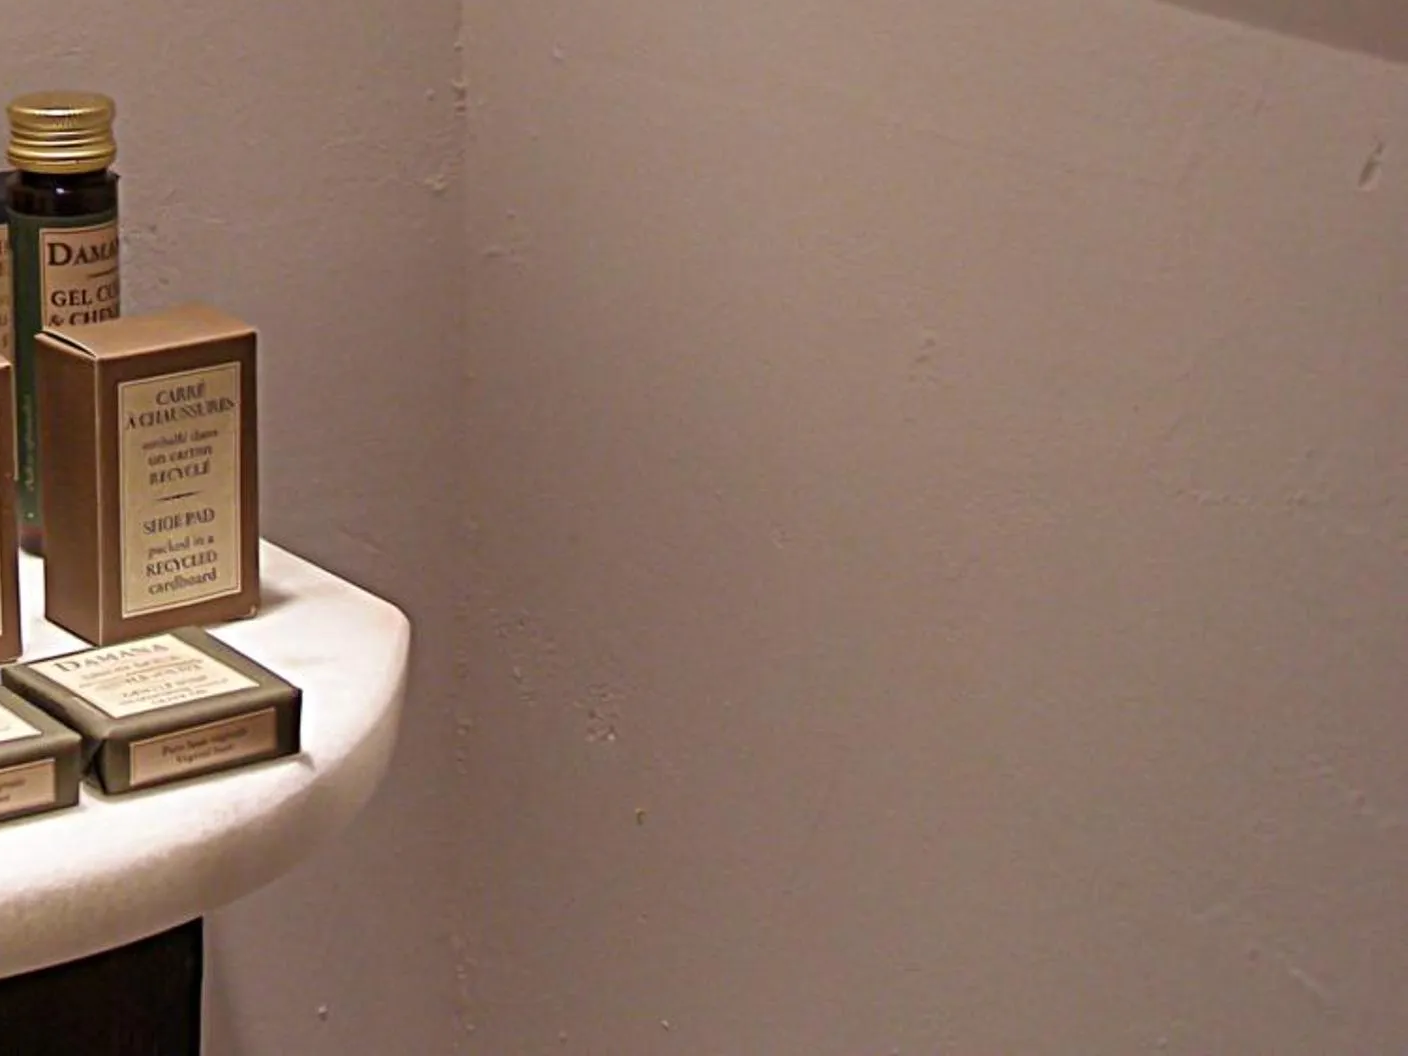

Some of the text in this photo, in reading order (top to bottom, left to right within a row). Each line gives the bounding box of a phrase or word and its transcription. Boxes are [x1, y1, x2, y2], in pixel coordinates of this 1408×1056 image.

[51, 289, 92, 307] GEL
[186, 508, 215, 526] PAD
[146, 549, 217, 577] RECYCLED
[52, 643, 171, 672] DAMANA
